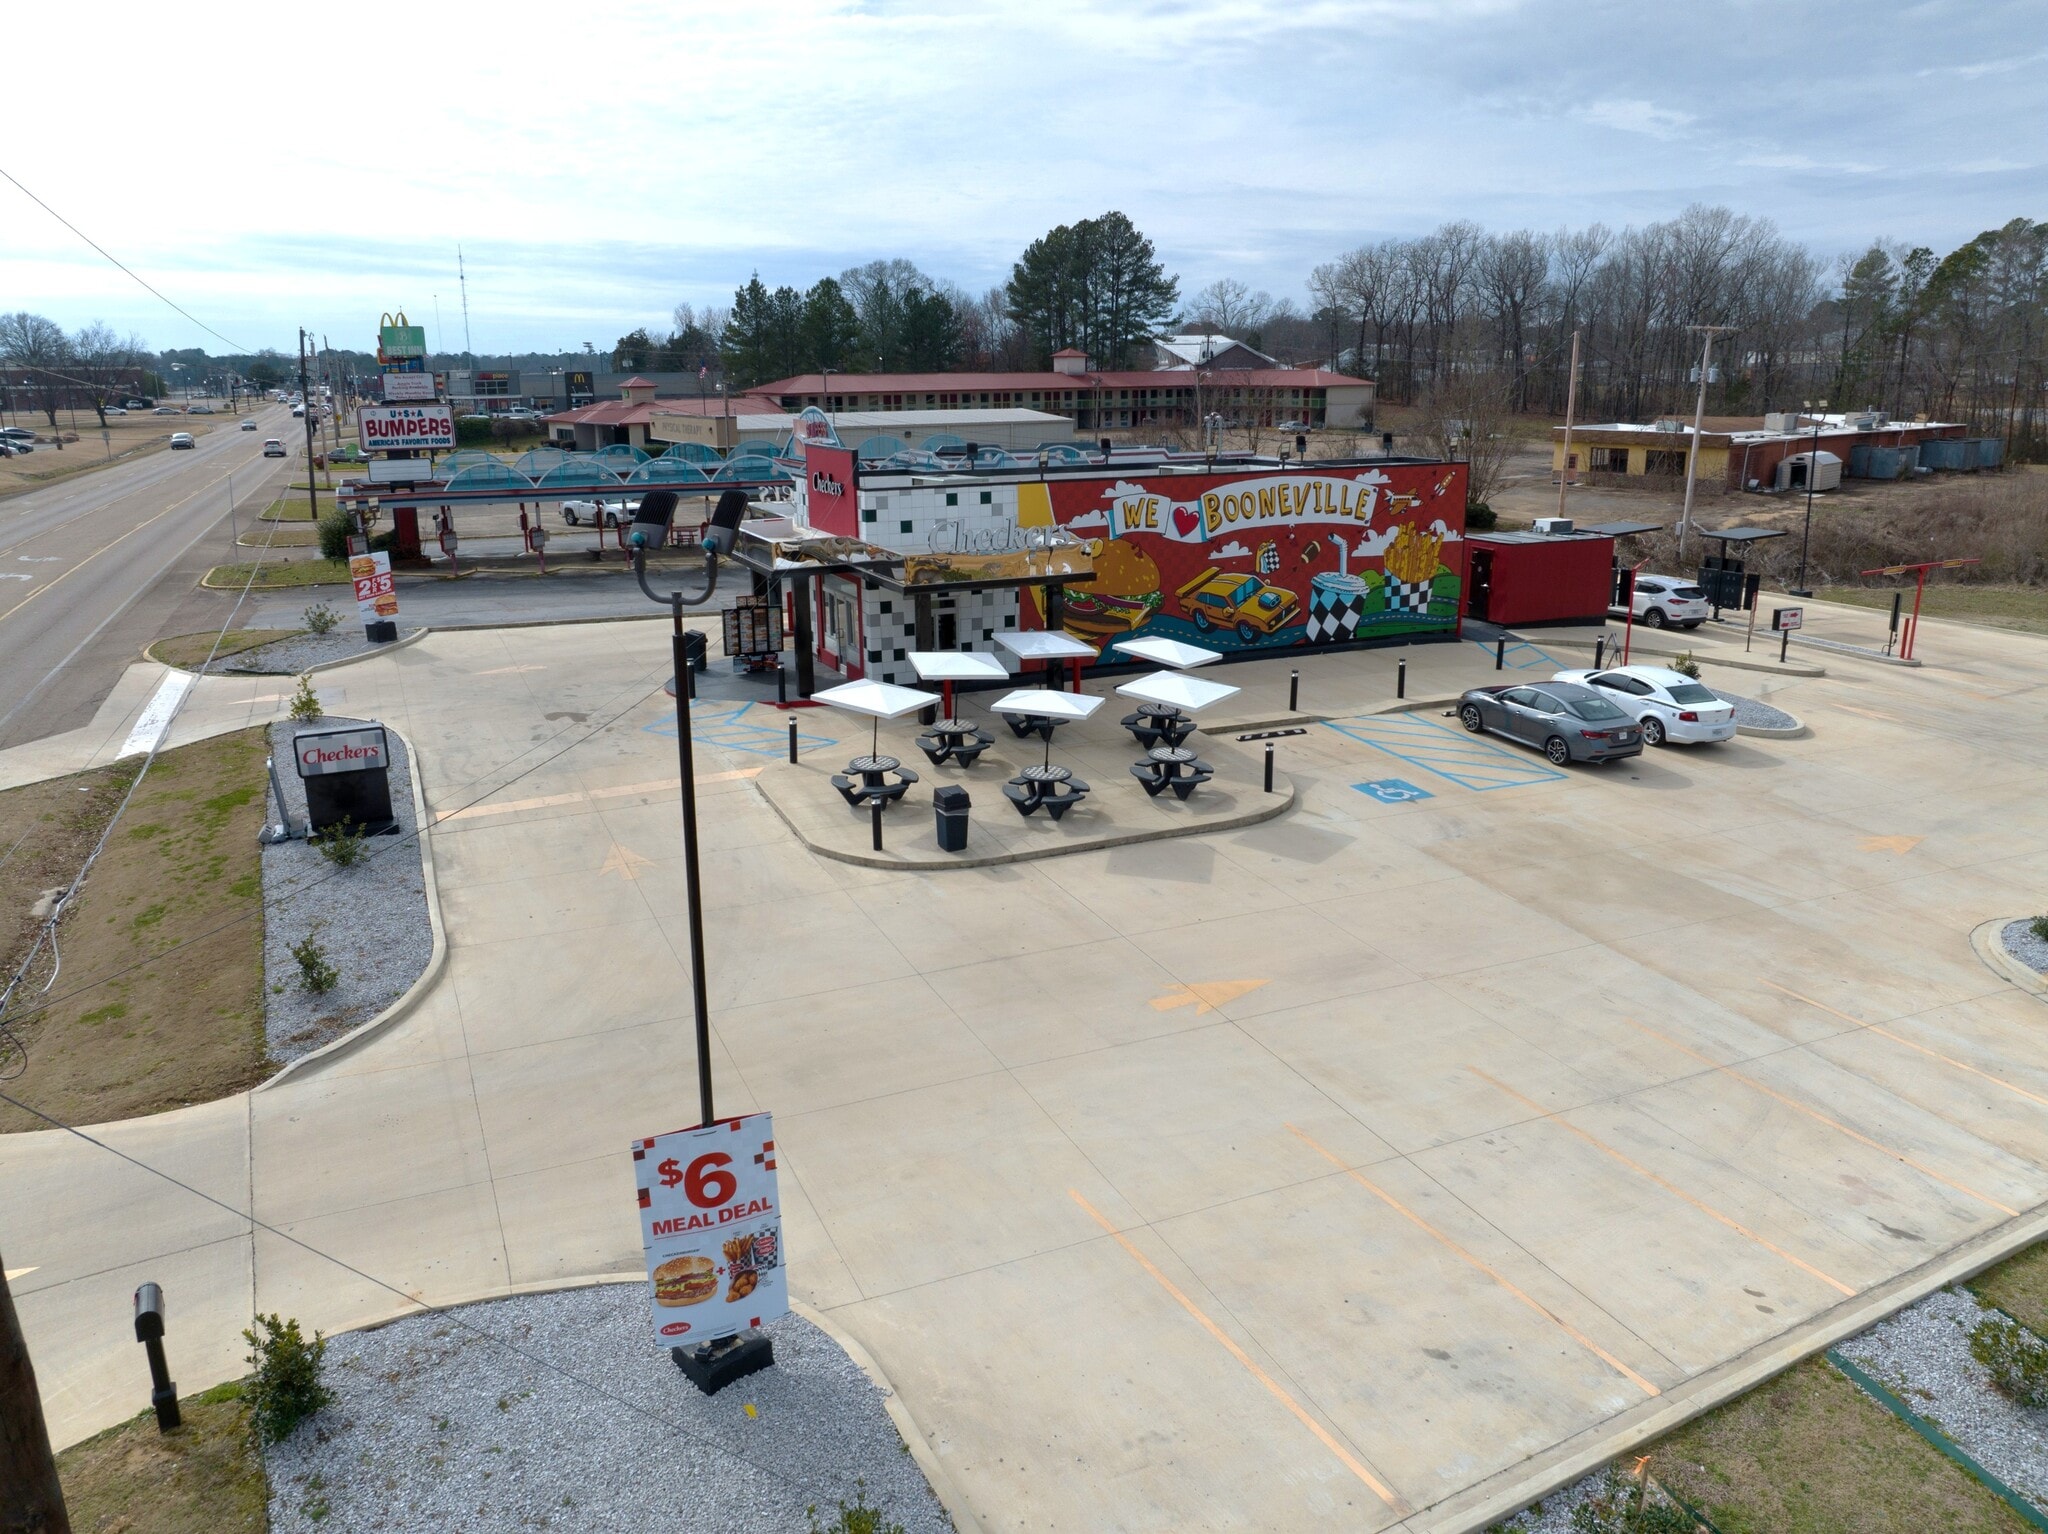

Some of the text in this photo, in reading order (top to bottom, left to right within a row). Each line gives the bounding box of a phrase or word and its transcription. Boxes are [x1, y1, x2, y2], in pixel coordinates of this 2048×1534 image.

[387, 345, 423, 355] BEST INN
[365, 417, 451, 437] BUMPERS
[368, 437, 451, 446] AMERICA'S FAVORITE FOODS
[812, 472, 845, 496] Checkers
[1123, 482, 1371, 532] WE BOONEVILLE
[928, 516, 1071, 554] Checkers
[358, 580, 371, 597] 2
[303, 745, 379, 765] Checkers
[657, 1152, 737, 1209] $6
[652, 1197, 773, 1236] MEAL DEAL
[662, 1324, 690, 1334] Checkers
